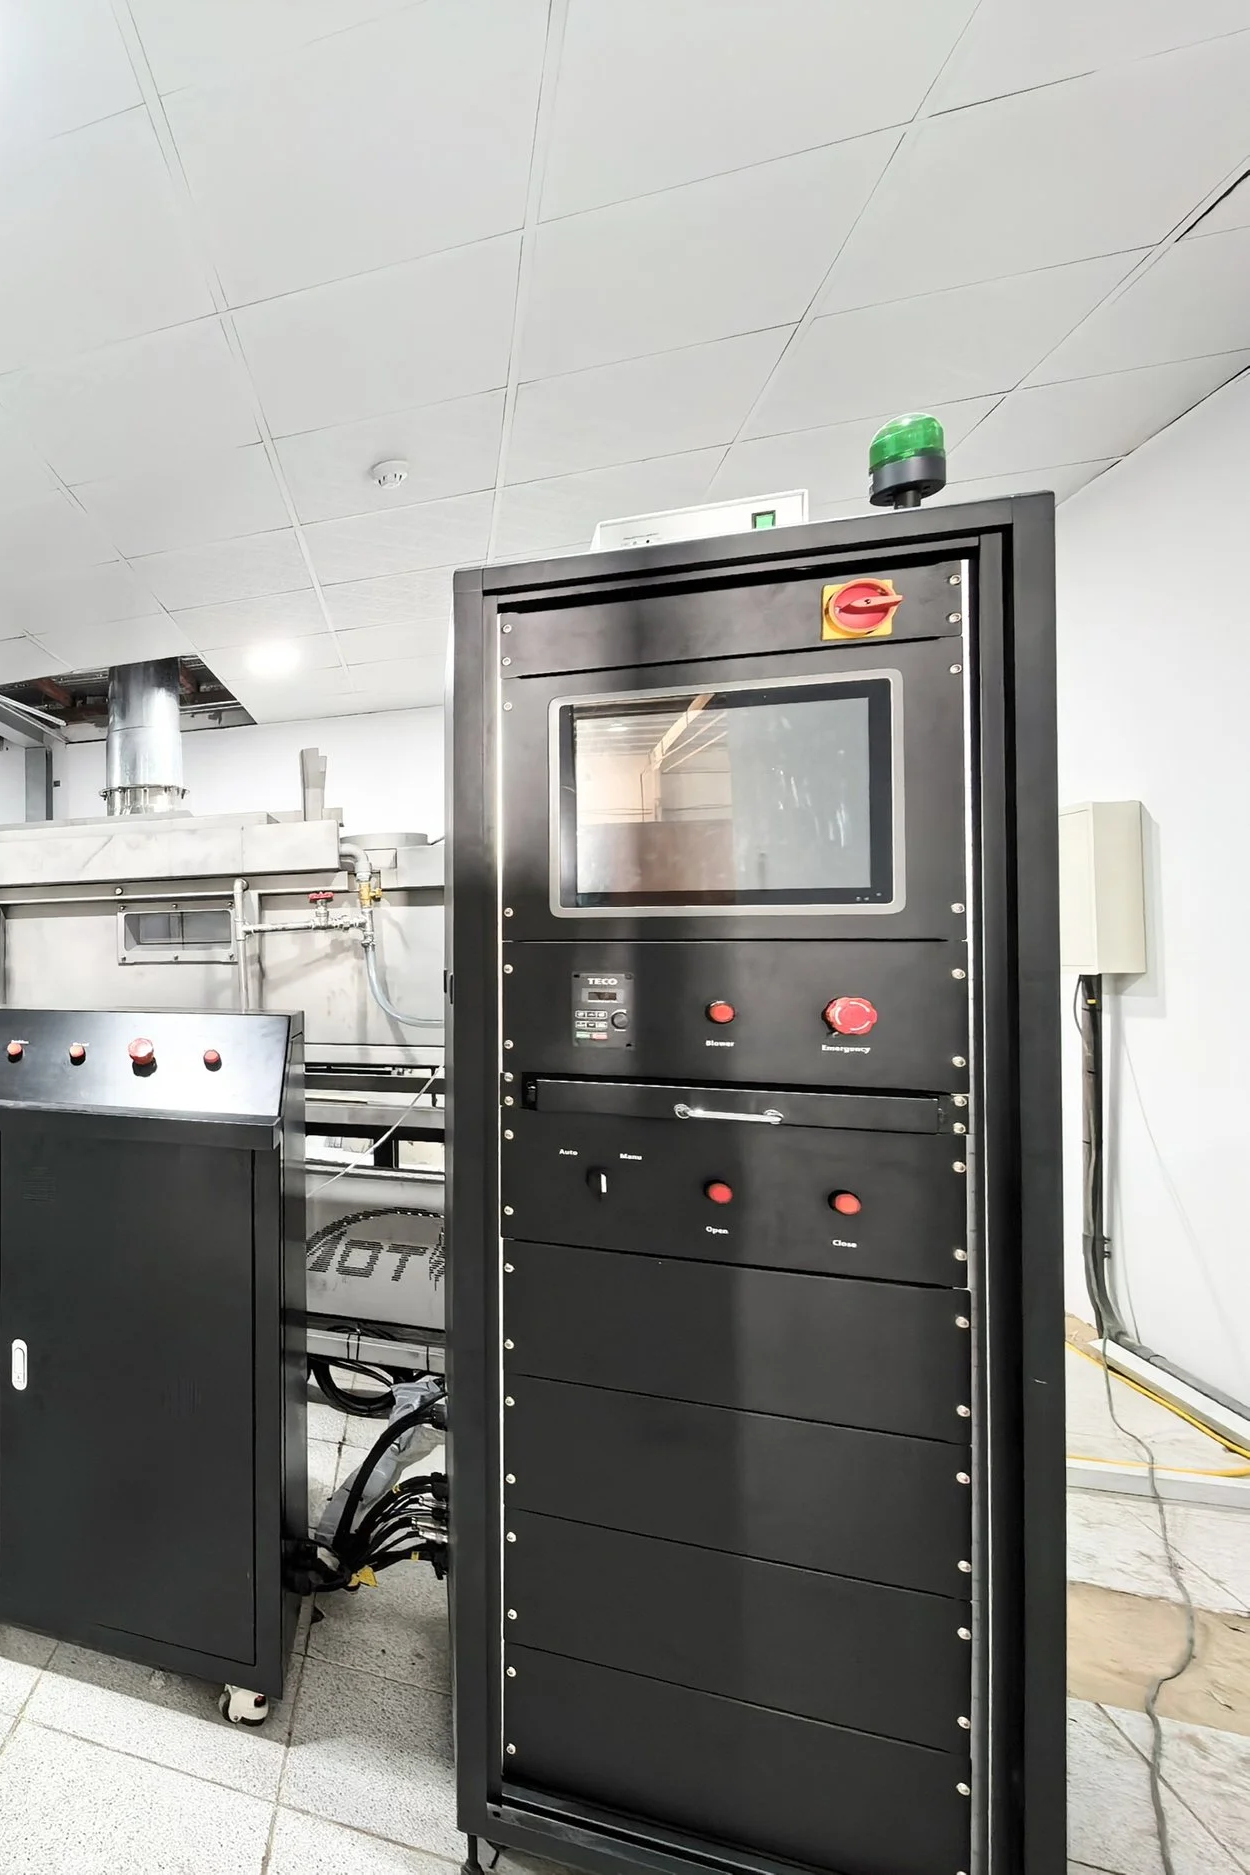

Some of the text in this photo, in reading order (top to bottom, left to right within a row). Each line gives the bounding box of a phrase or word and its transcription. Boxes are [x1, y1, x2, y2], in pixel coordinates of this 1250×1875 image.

[587, 977, 619, 986] TECO
[705, 1039, 735, 1048] Blower
[821, 1044, 871, 1054] Emergency
[559, 1148, 578, 1156] Auto
[705, 1226, 730, 1235] Open
[832, 1239, 857, 1248] Close
